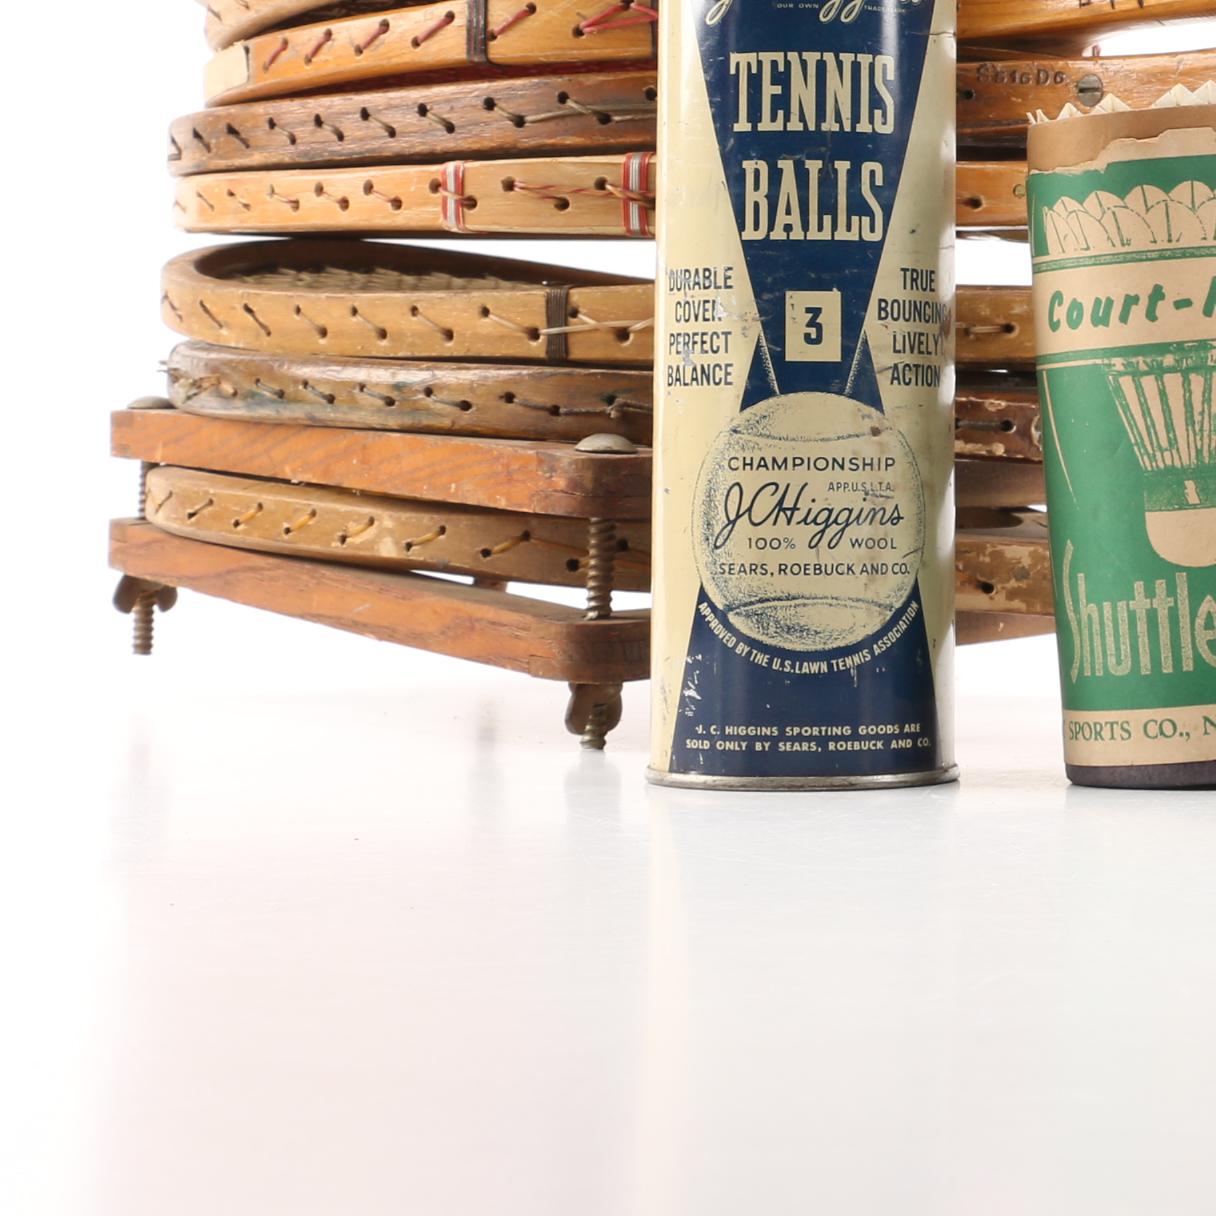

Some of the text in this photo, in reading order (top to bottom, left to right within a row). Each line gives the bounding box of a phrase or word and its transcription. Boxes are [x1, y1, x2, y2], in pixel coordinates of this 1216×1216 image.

[730, 51, 895, 134] TENNIS
[741, 159, 883, 241] BALLS
[669, 266, 734, 292] DURABLE
[900, 268, 936, 292] TRUE
[803, 306, 824, 346] 3
[669, 330, 733, 355] PERFECT
[892, 330, 941, 356] LIVELY
[667, 363, 734, 386] BALANCE
[890, 362, 941, 388] ACTION
[728, 456, 896, 472] CHAMPIONSHIP
[748, 537, 897, 550] 100% WOOL
[719, 562, 910, 577] SEARS, ROEBUCK AND CO.
[698, 601, 738, 649] APPROVED
[734, 641, 750, 658] BY
[749, 649, 769, 668] THE
[830, 648, 872, 673] TENNIS
[872, 600, 921, 657] ASSOCIATION
[725, 725, 779, 737] HIGGINS
[785, 726, 853, 736] SPORTING
[858, 724, 901, 735] GOODS
[903, 722, 921, 733] ARE
[1068, 720, 1132, 742] SPORTS
[1143, 718, 1191, 741] CO.,
[685, 736, 932, 753] SOLD ONLY BY SEARS, ROEBUCK AND CO.
